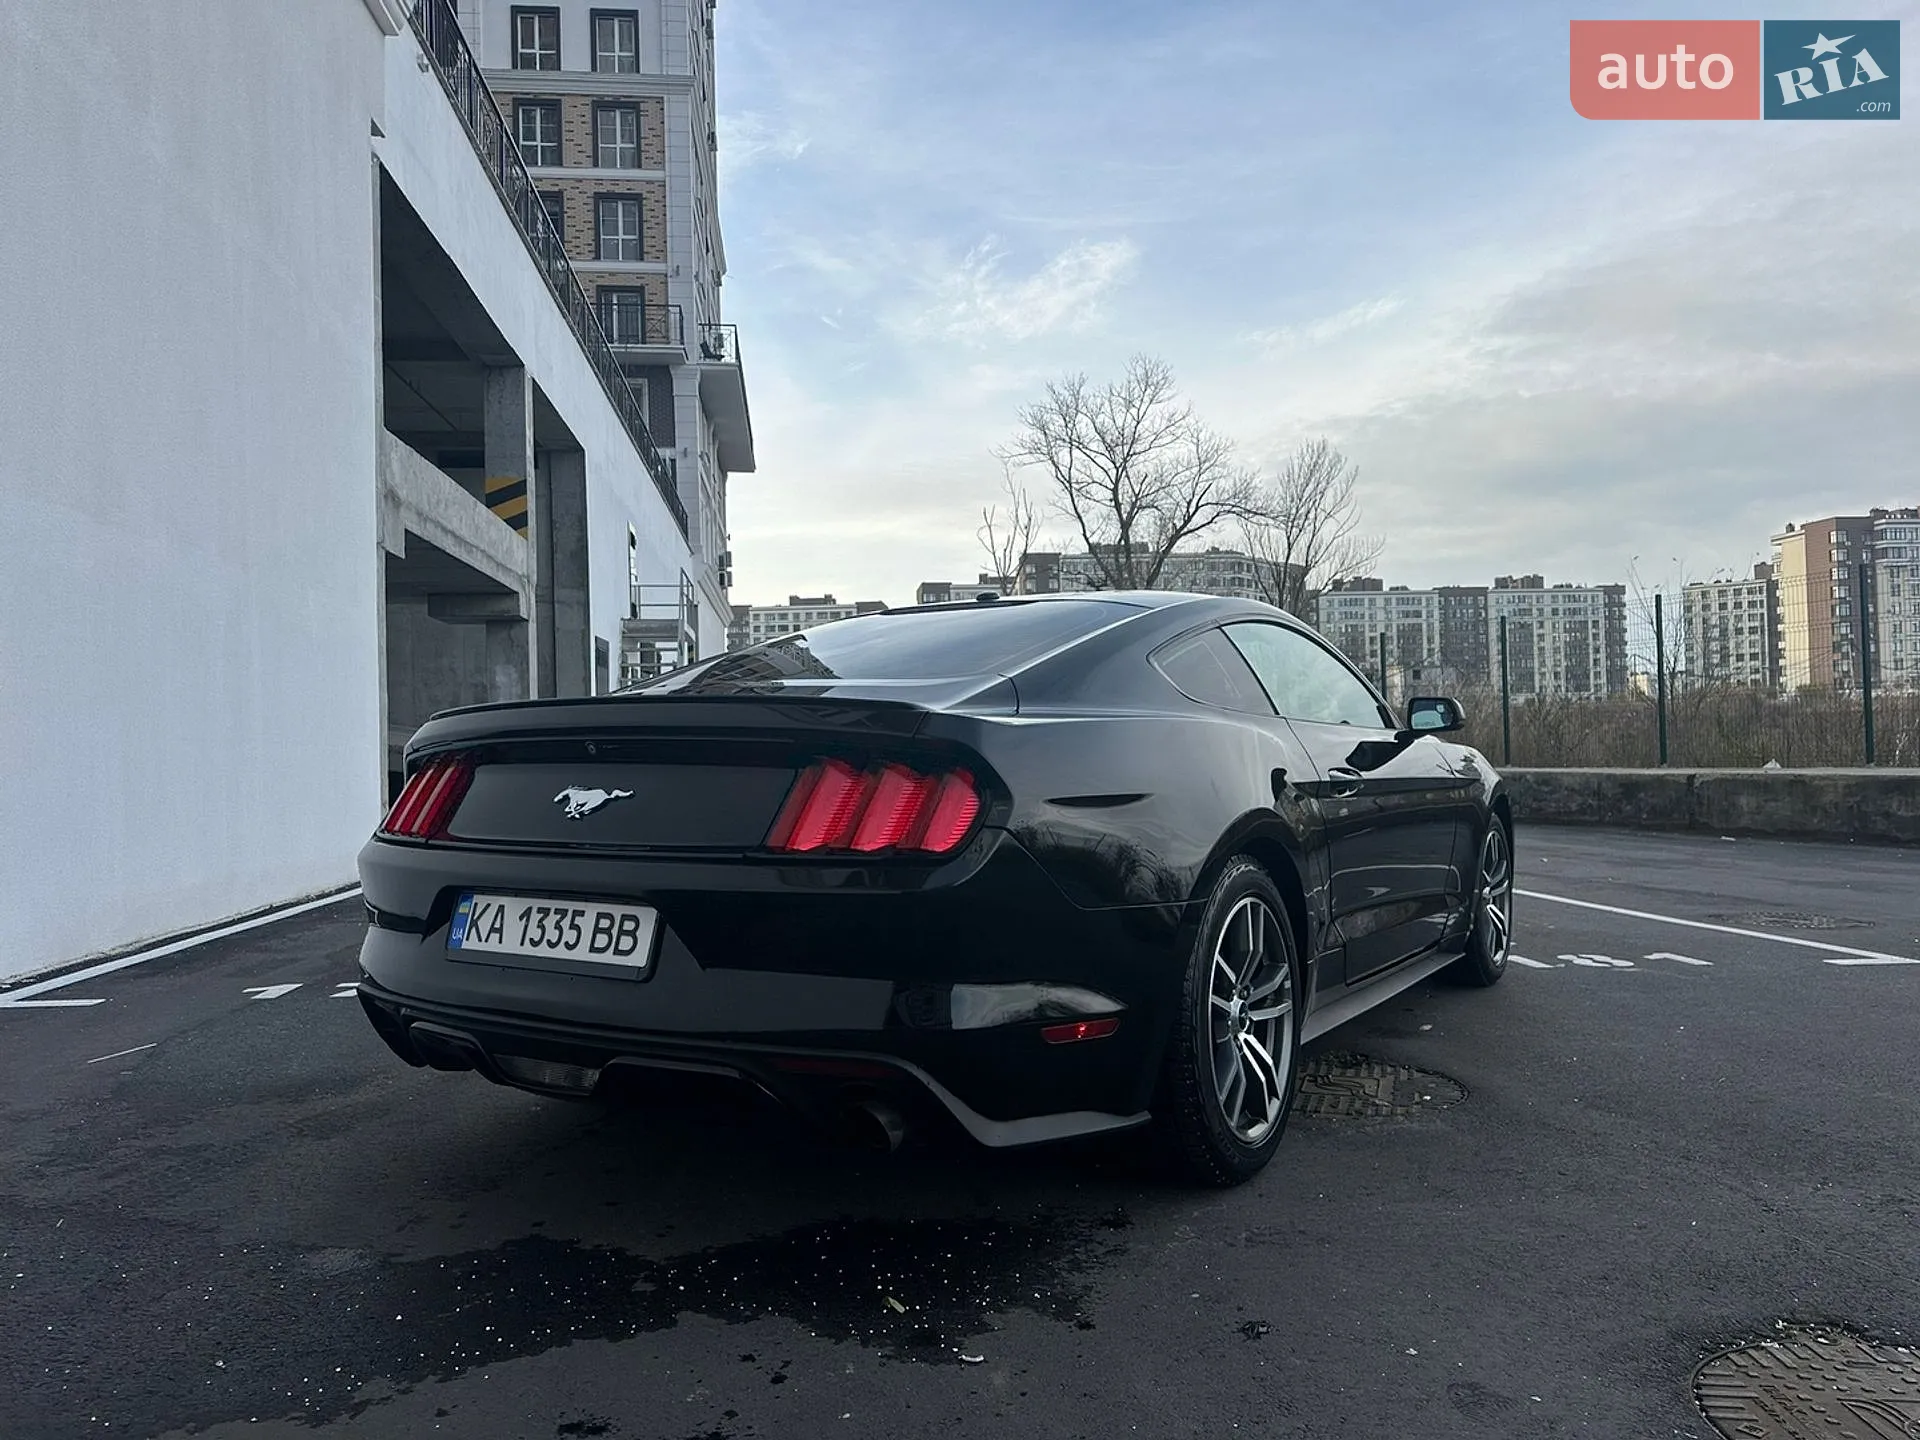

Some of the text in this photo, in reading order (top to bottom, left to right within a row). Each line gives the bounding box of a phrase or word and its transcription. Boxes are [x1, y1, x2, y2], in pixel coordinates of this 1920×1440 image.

[465, 902, 641, 957] KA 1335 BB
